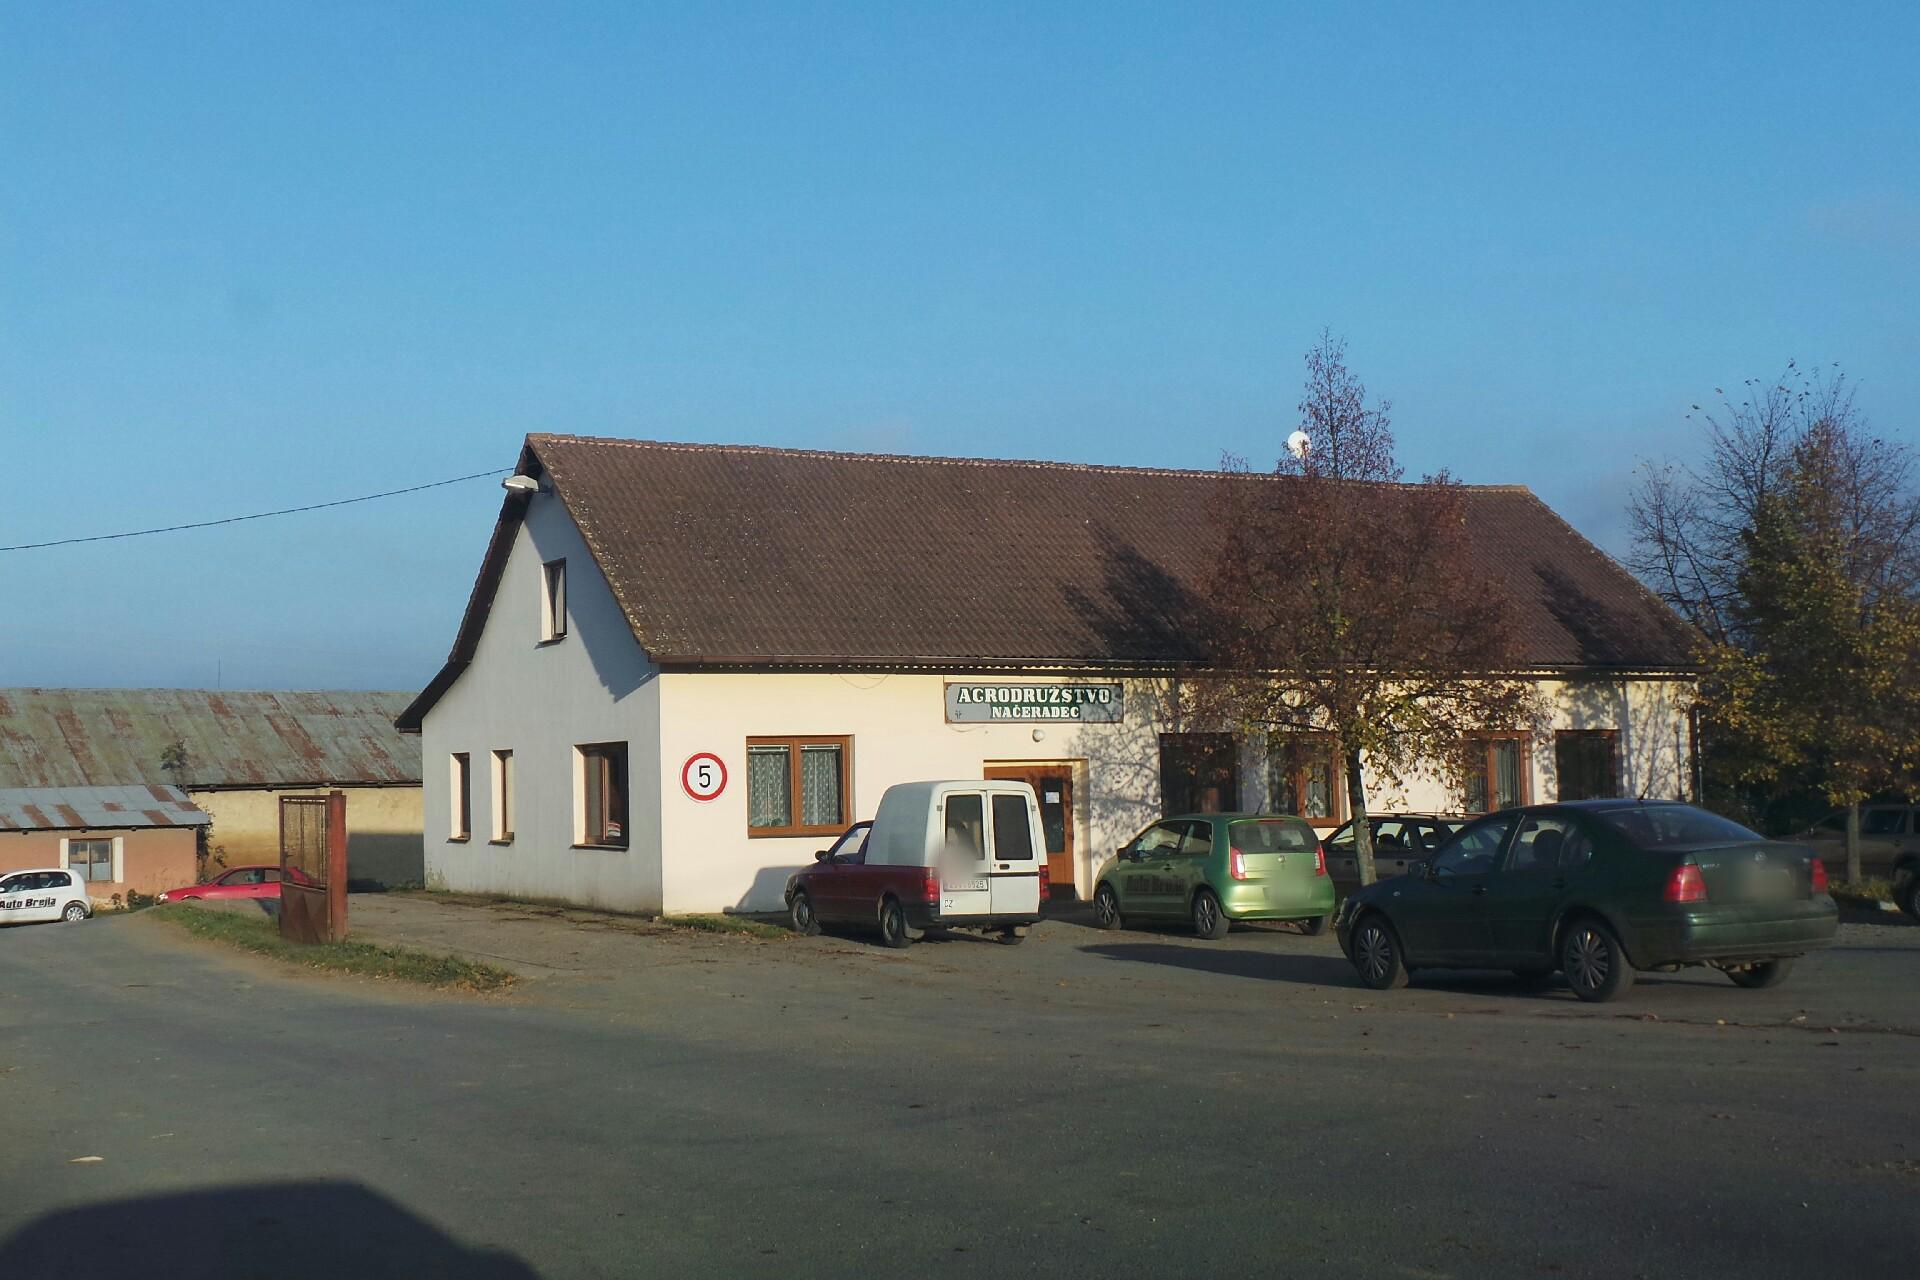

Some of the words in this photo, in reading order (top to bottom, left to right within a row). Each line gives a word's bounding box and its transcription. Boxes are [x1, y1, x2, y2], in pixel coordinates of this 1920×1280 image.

[957, 685, 1111, 704] AGRODRUŽSTVO
[991, 705, 1080, 719] NAČERADEC
[698, 765, 711, 788] 5
[0, 899, 23, 909] Auto
